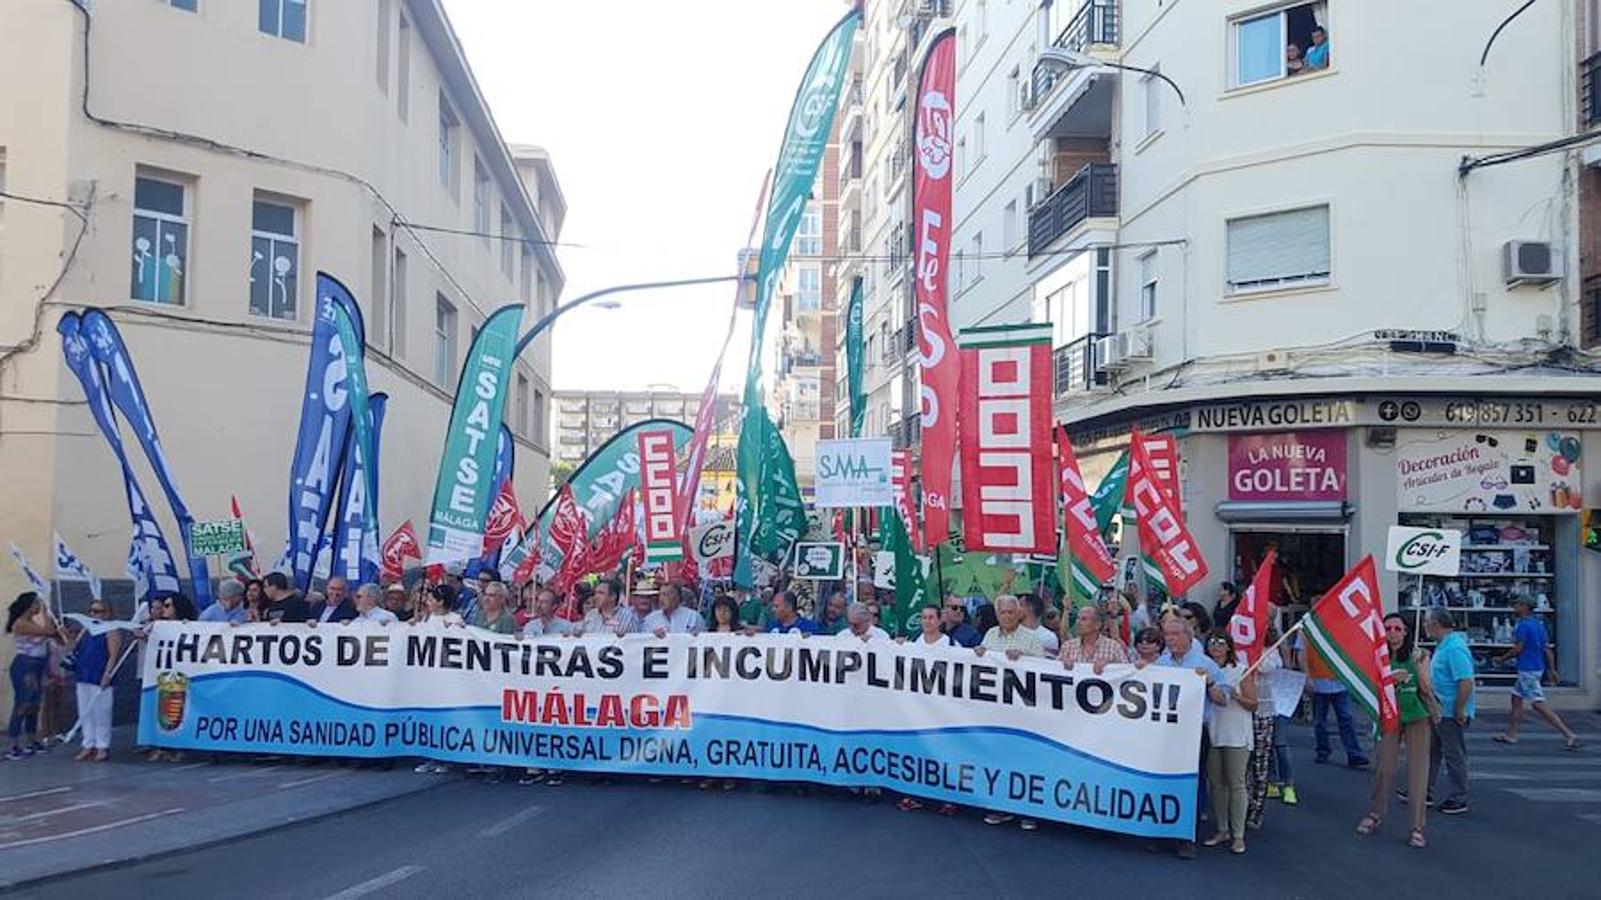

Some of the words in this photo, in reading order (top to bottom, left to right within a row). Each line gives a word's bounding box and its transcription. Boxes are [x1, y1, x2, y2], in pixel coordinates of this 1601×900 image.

[1198, 407, 1264, 428] NUEVA
[1269, 401, 1350, 425] GOLETA
[1446, 403, 1476, 422] 619
[1481, 403, 1511, 423] 857
[1514, 403, 1543, 422] 351
[450, 371, 501, 512] SATSE
[1248, 447, 1270, 464] LA
[1272, 444, 1326, 462] NUEVA
[1398, 445, 1480, 475] Decoración
[643, 436, 675, 539] CCOO
[1233, 467, 1339, 491] GOLETA
[192, 521, 243, 535] SATSE
[155, 634, 322, 669] ¡¡HARTOS
[336, 635, 390, 667] DE
[406, 635, 624, 679] MENTIRAS
[642, 646, 669, 679] E
[687, 647, 1181, 723] INCUMPLIMIENTOS!!
[502, 686, 691, 728] MÁLAGA
[195, 716, 238, 741] POR
[243, 717, 284, 743] UNA
[293, 719, 375, 748] SANIDAD
[384, 715, 476, 752] PÚBLICA
[482, 728, 611, 760] UNIVERSAL
[619, 737, 698, 768] DIGNA,
[706, 740, 827, 776] GRATUITA,
[833, 746, 974, 793] ACCESIBLE
[984, 767, 1001, 796] Y
[1009, 771, 1045, 804] DE
[1054, 778, 1181, 826] CALIDAD
